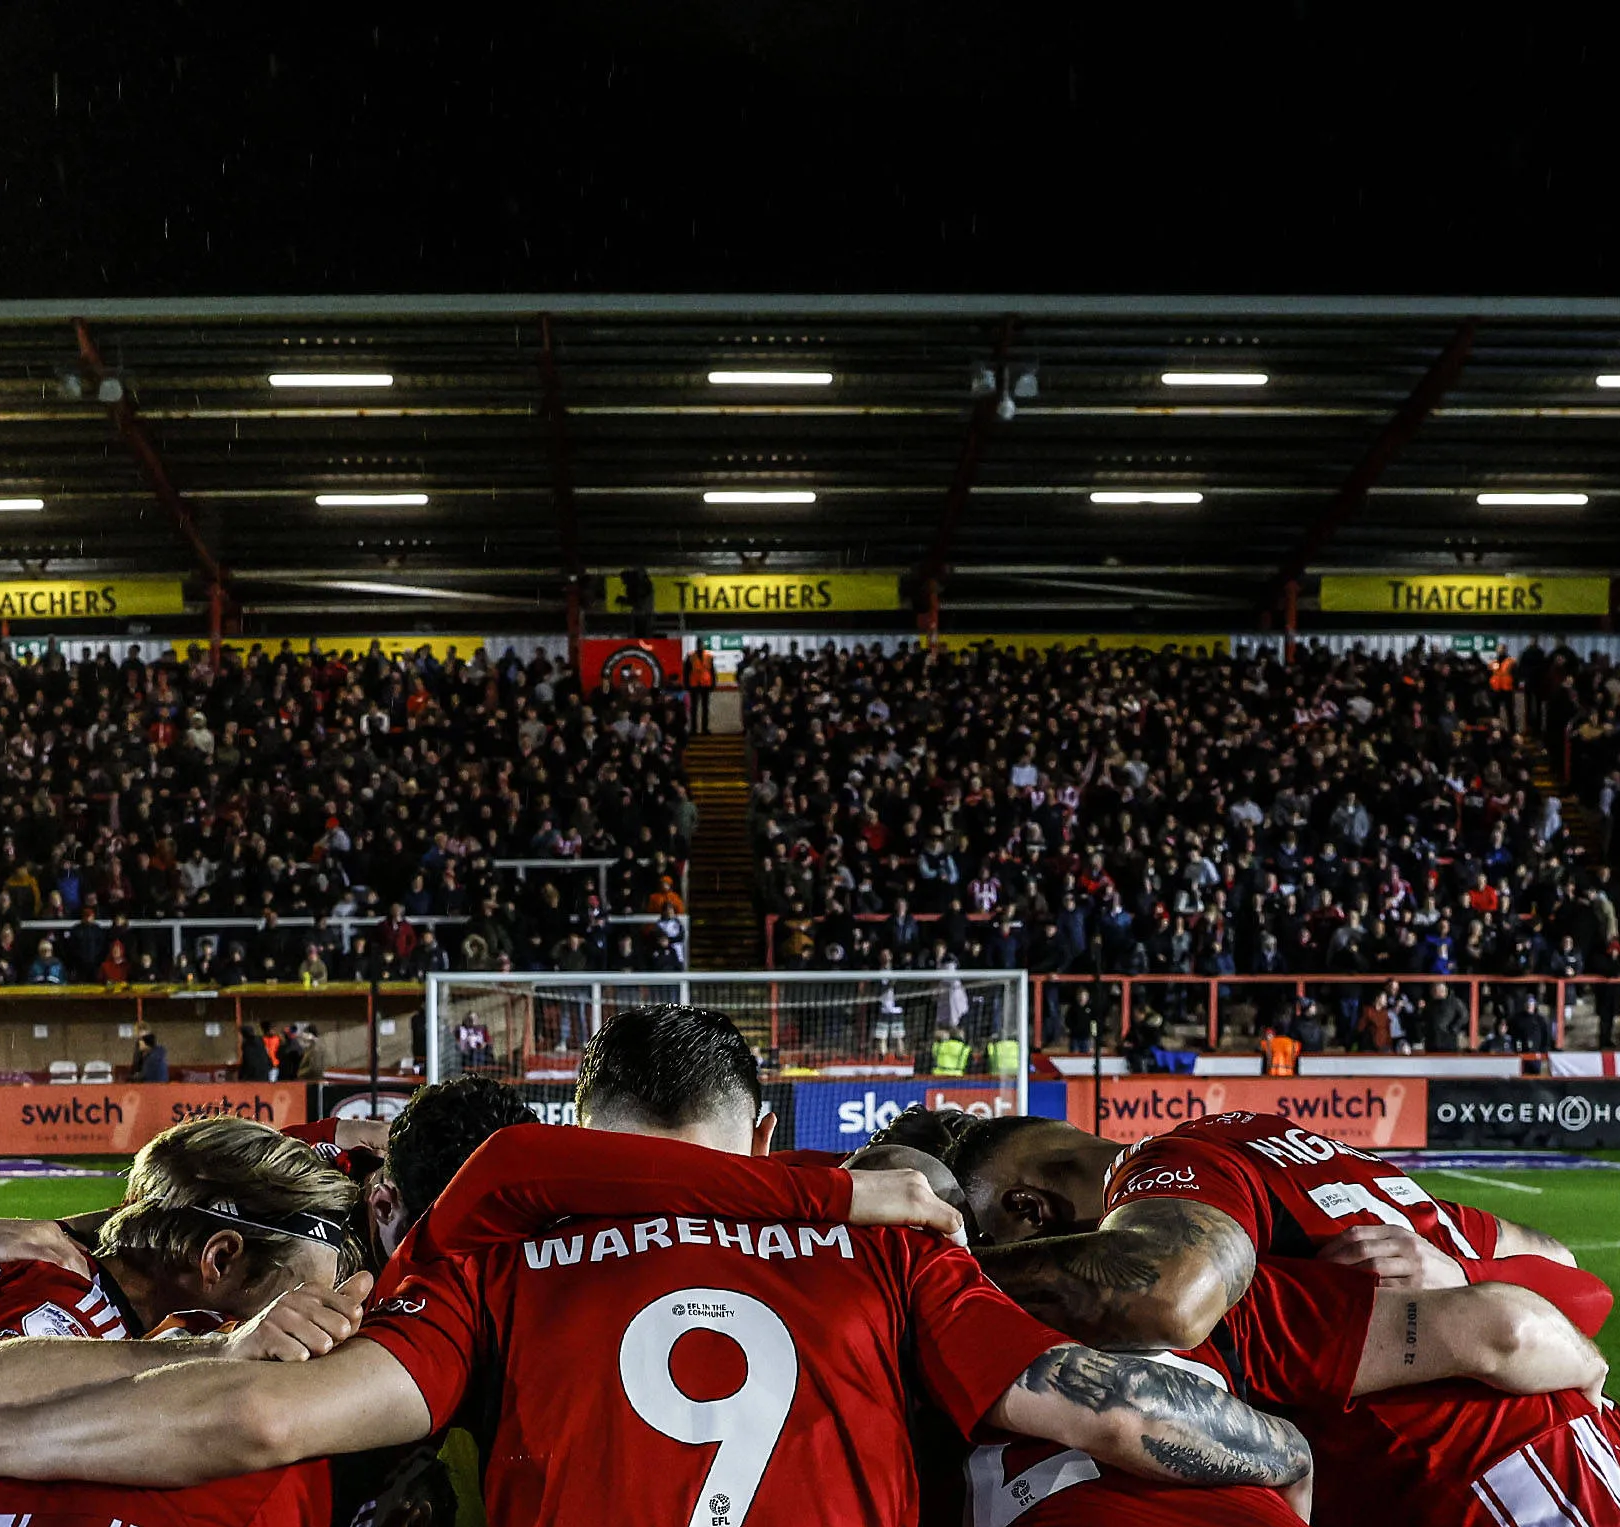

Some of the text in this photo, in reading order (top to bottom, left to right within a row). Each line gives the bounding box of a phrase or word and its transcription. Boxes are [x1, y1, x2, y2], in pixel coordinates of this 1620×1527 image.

[21, 1096, 123, 1125] switch
[1098, 1089, 1207, 1120] switch
[1276, 1088, 1387, 1119] switch
[1437, 1102, 1555, 1124] OXYGEN
[522, 1216, 855, 1270] WAREHAM
[687, 1302, 727, 1312] EFL IN THE
[687, 1309, 735, 1318] COMMUNITY
[711, 1516, 731, 1527] EFL
